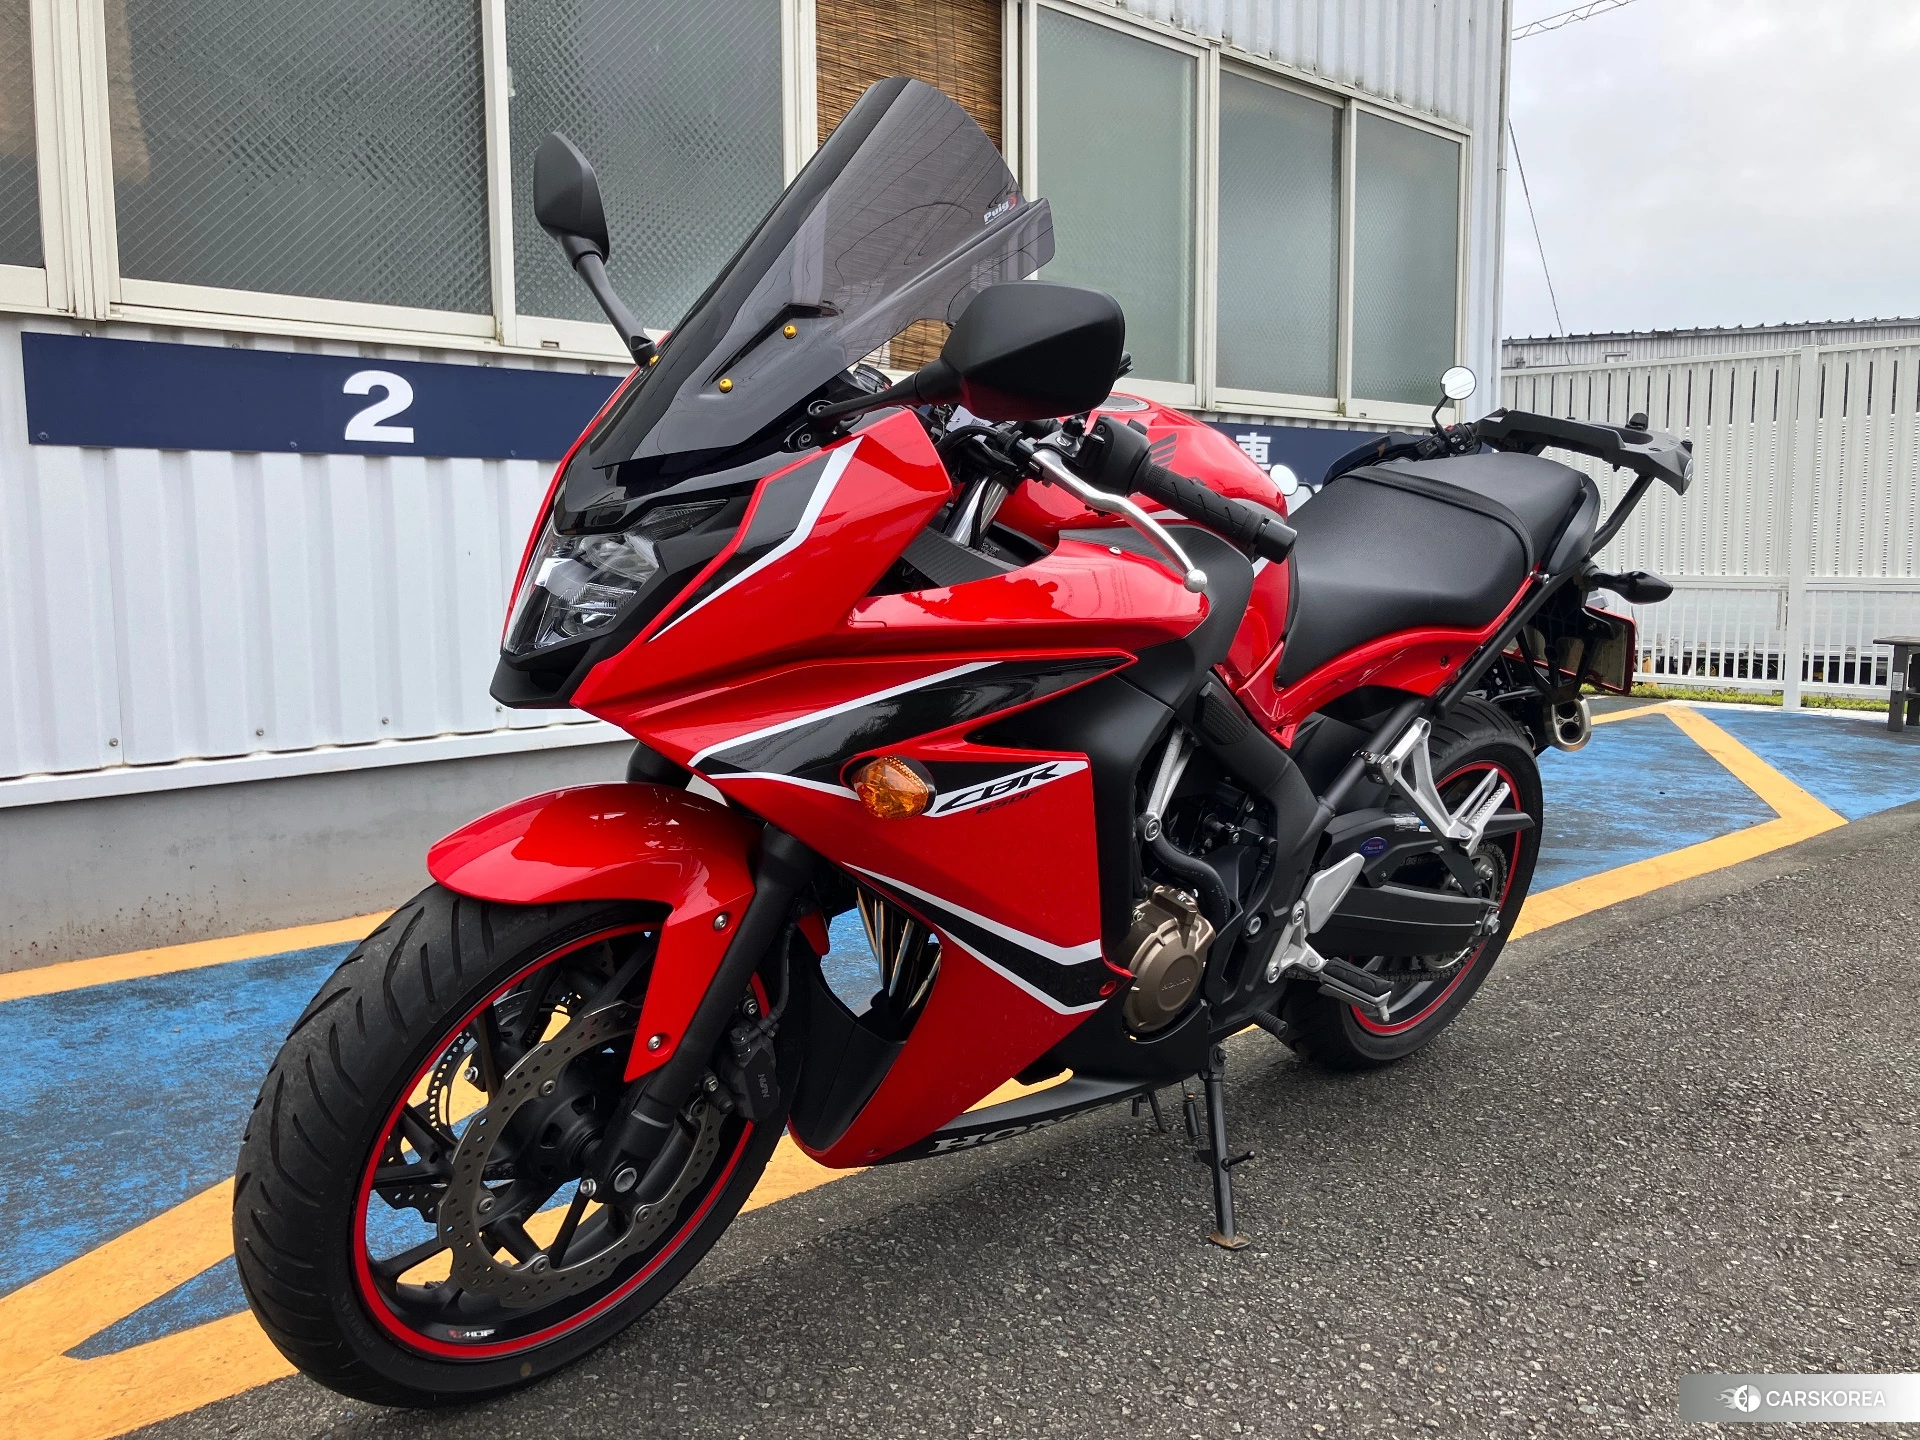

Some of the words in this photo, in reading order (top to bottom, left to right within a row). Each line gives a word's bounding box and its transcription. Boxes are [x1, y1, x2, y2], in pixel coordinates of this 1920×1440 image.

[984, 201, 1010, 223] Puig
[343, 370, 414, 443] 2
[935, 763, 1060, 814] CBR
